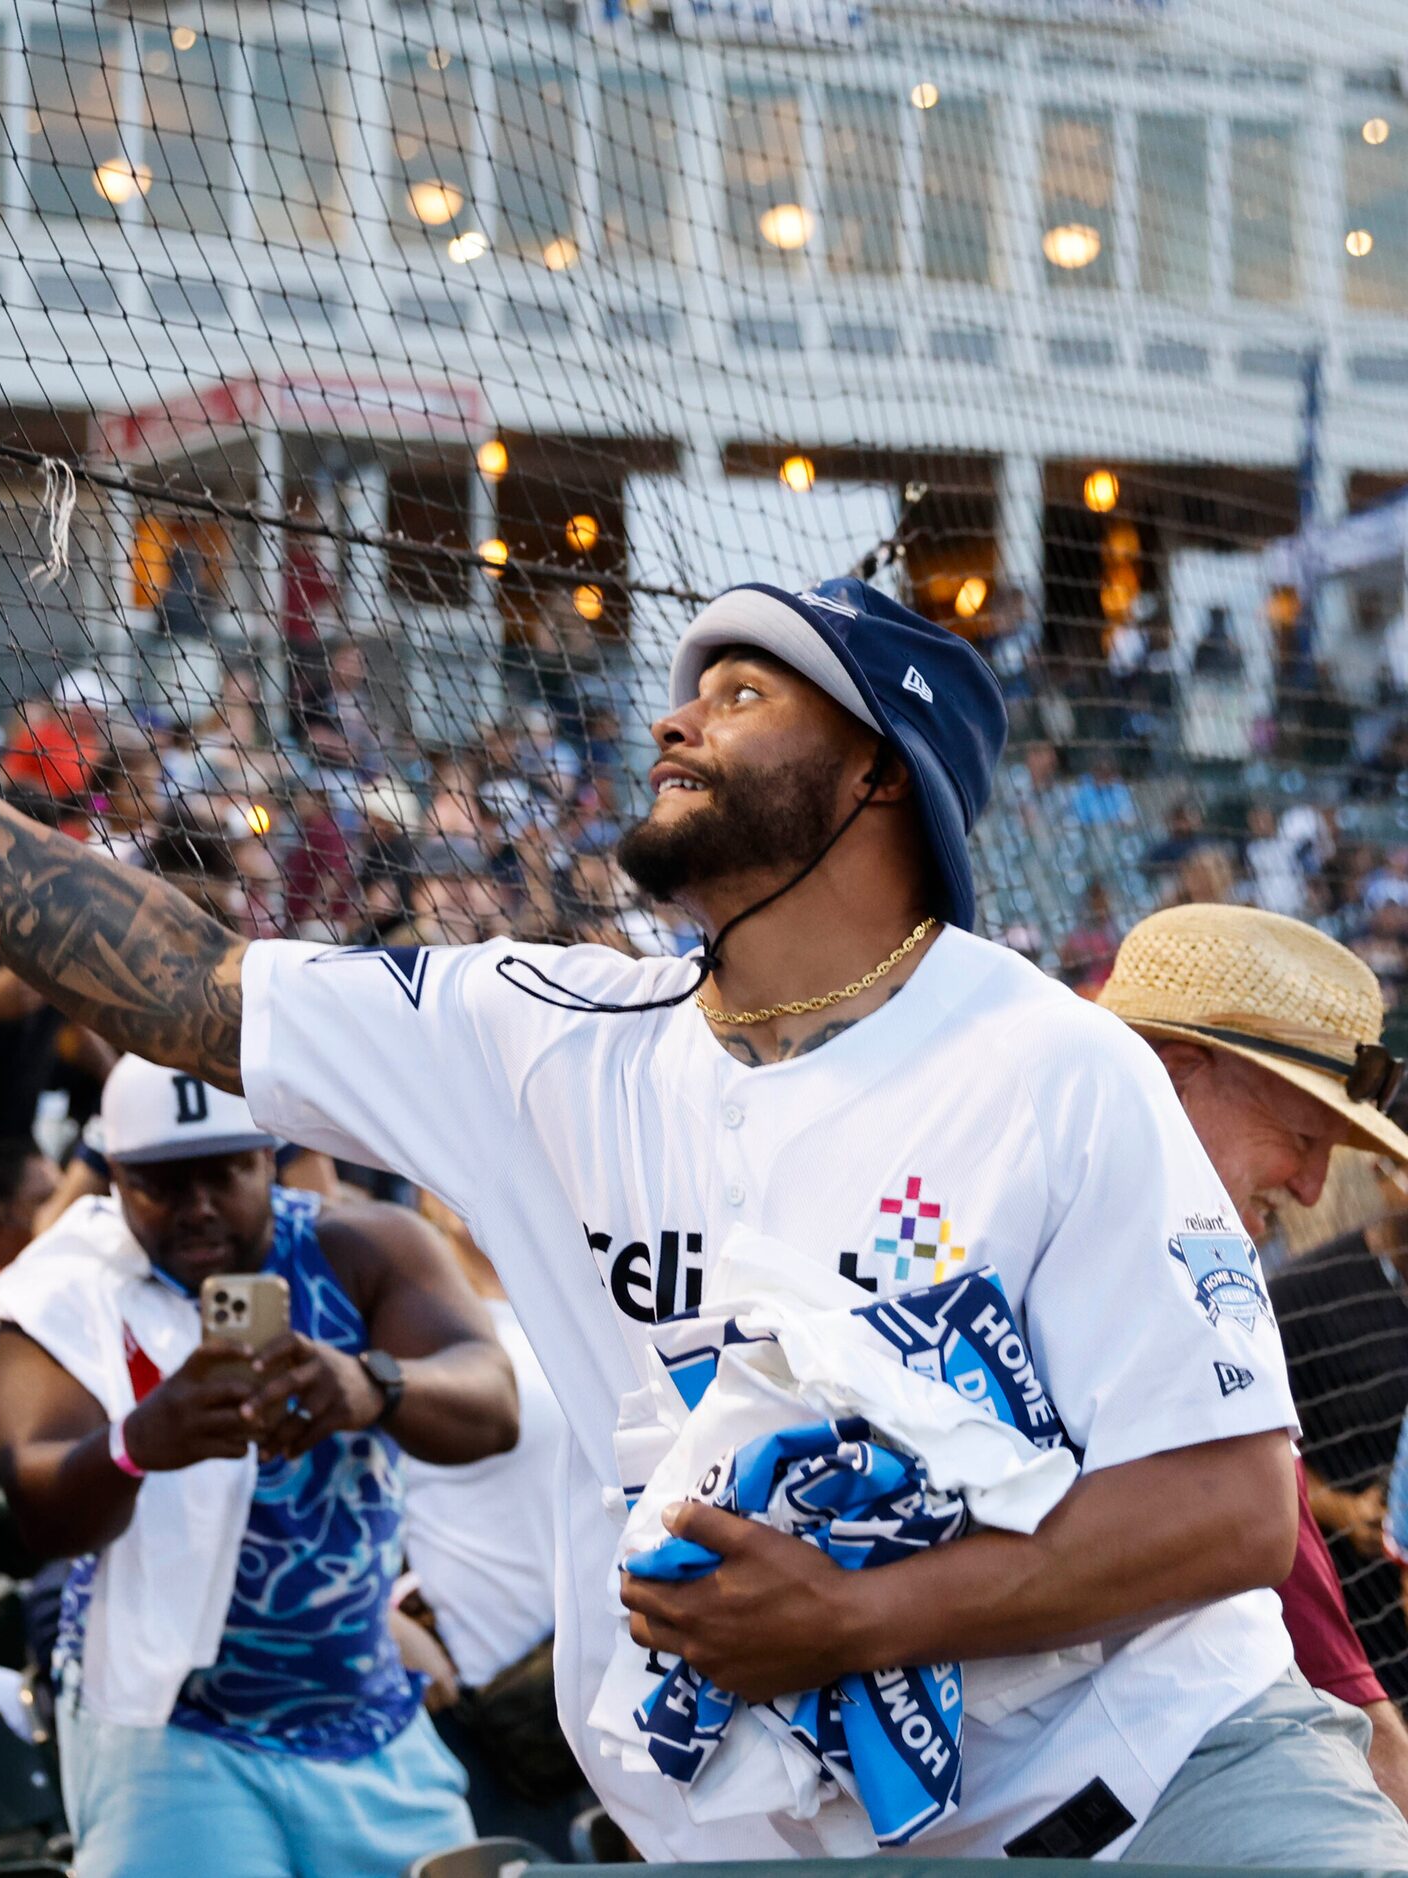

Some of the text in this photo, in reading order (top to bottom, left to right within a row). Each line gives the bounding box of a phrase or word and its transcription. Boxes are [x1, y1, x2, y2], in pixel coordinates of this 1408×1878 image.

[172, 1075, 208, 1125] D
[1202, 1270, 1233, 1294] HOME
[970, 1303, 1055, 1427] HOME
[873, 1667, 951, 1778] HOME
